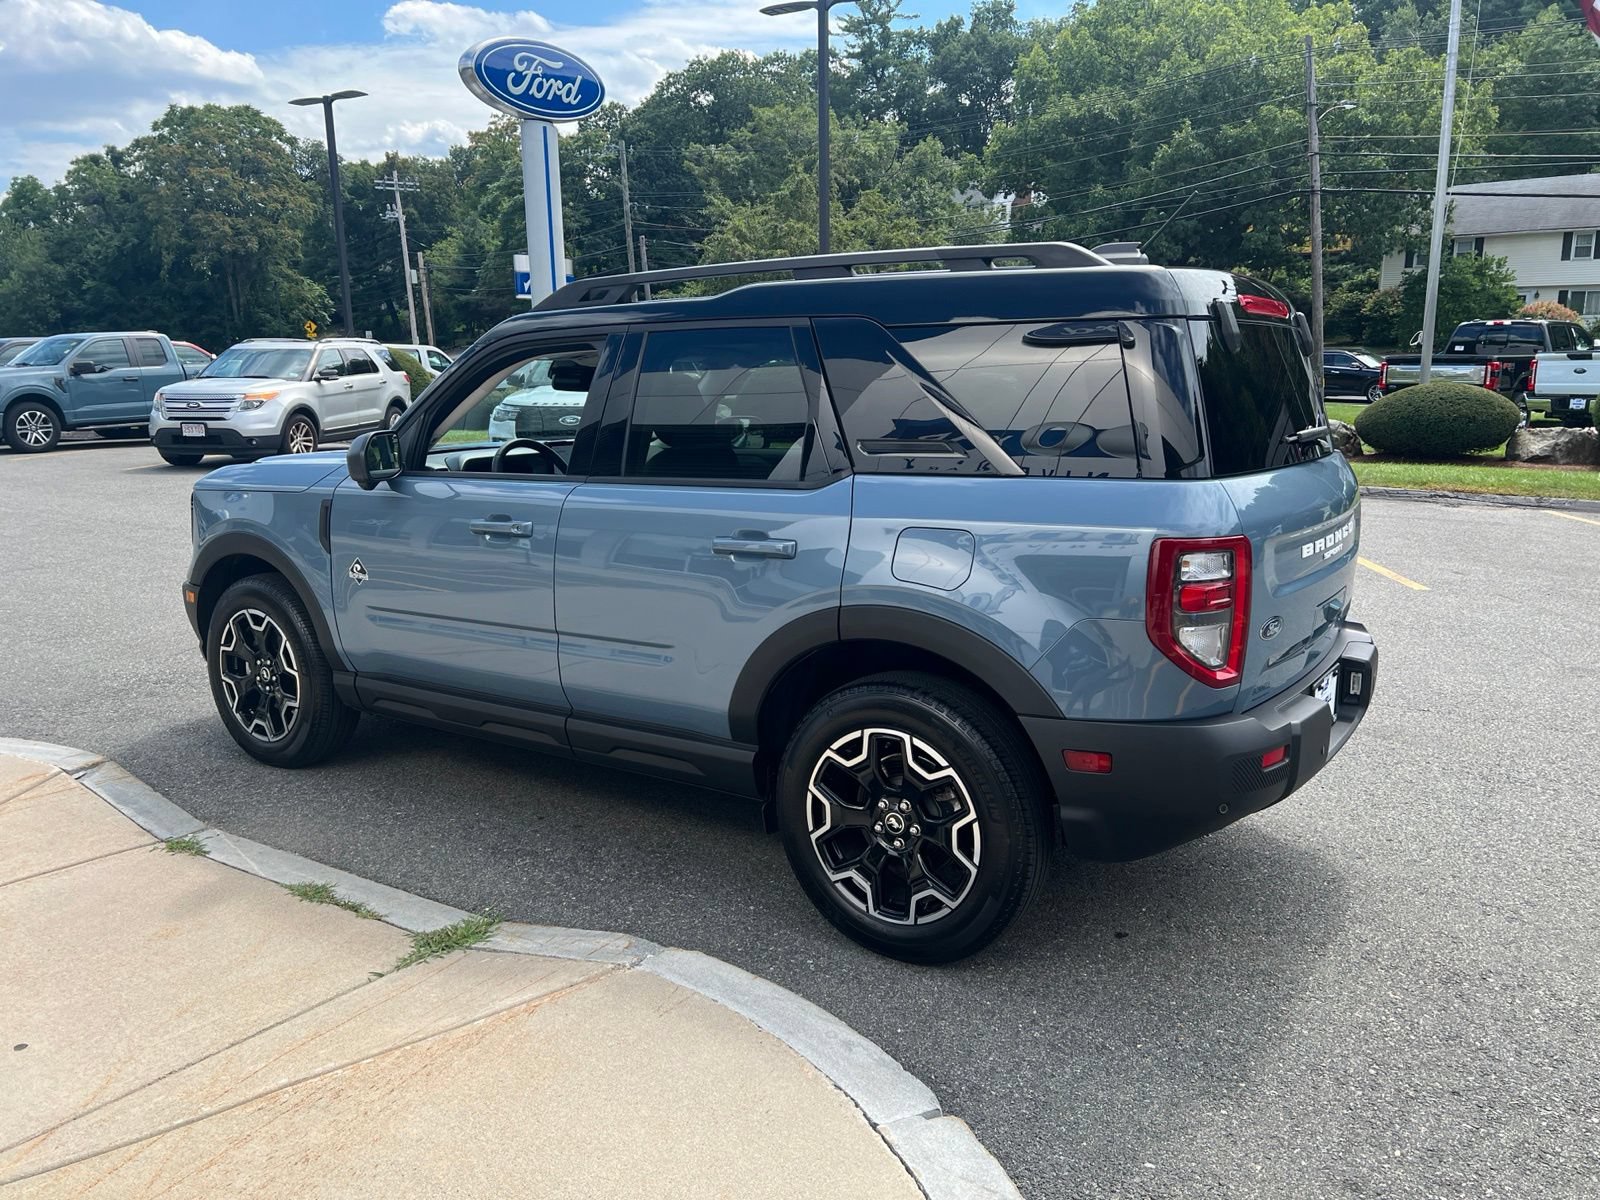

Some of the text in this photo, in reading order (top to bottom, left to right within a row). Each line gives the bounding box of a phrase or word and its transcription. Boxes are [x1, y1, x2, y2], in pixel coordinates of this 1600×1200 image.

[506, 51, 582, 105] Ford
[1301, 520, 1354, 559] BRONCO
[1323, 543, 1344, 560] SPORT
